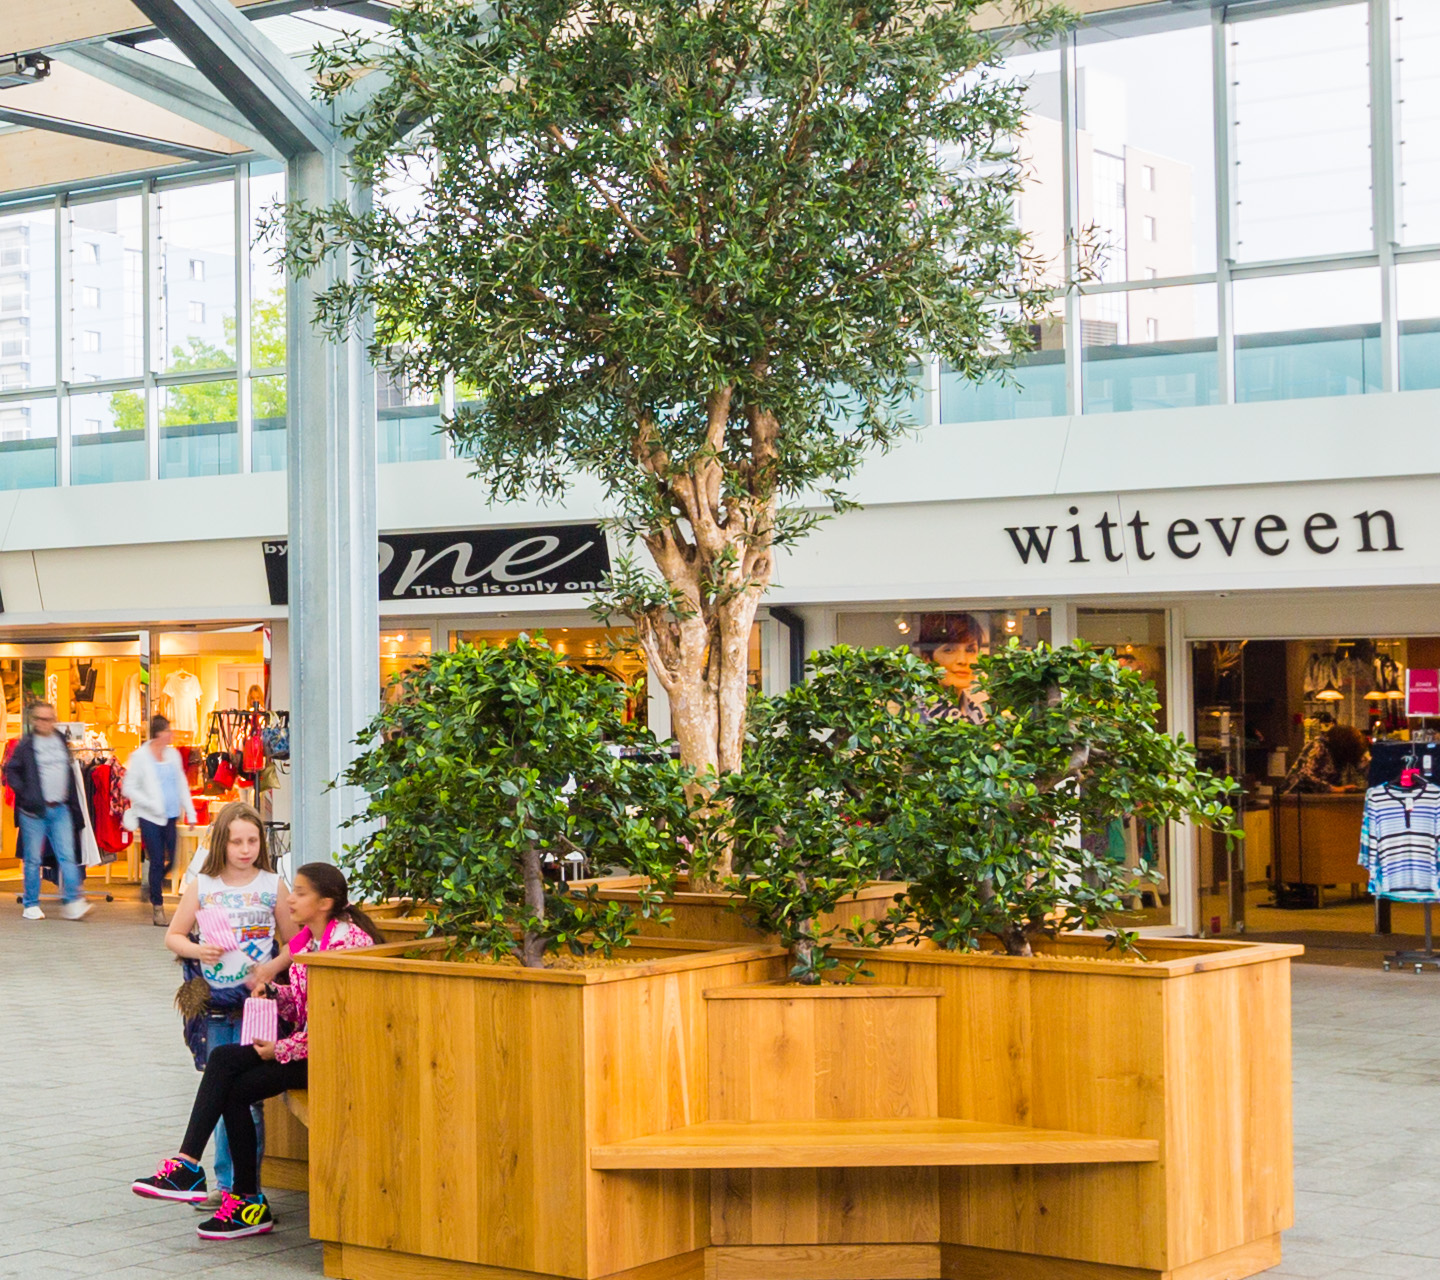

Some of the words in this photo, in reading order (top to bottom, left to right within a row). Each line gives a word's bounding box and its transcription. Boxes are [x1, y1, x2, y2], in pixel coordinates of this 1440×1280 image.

[264, 543, 288, 556] by
[1004, 505, 1404, 564] witteveen
[379, 535, 595, 596] ne
[411, 583, 479, 596] There
[482, 583, 501, 595] is
[505, 579, 558, 595] only
